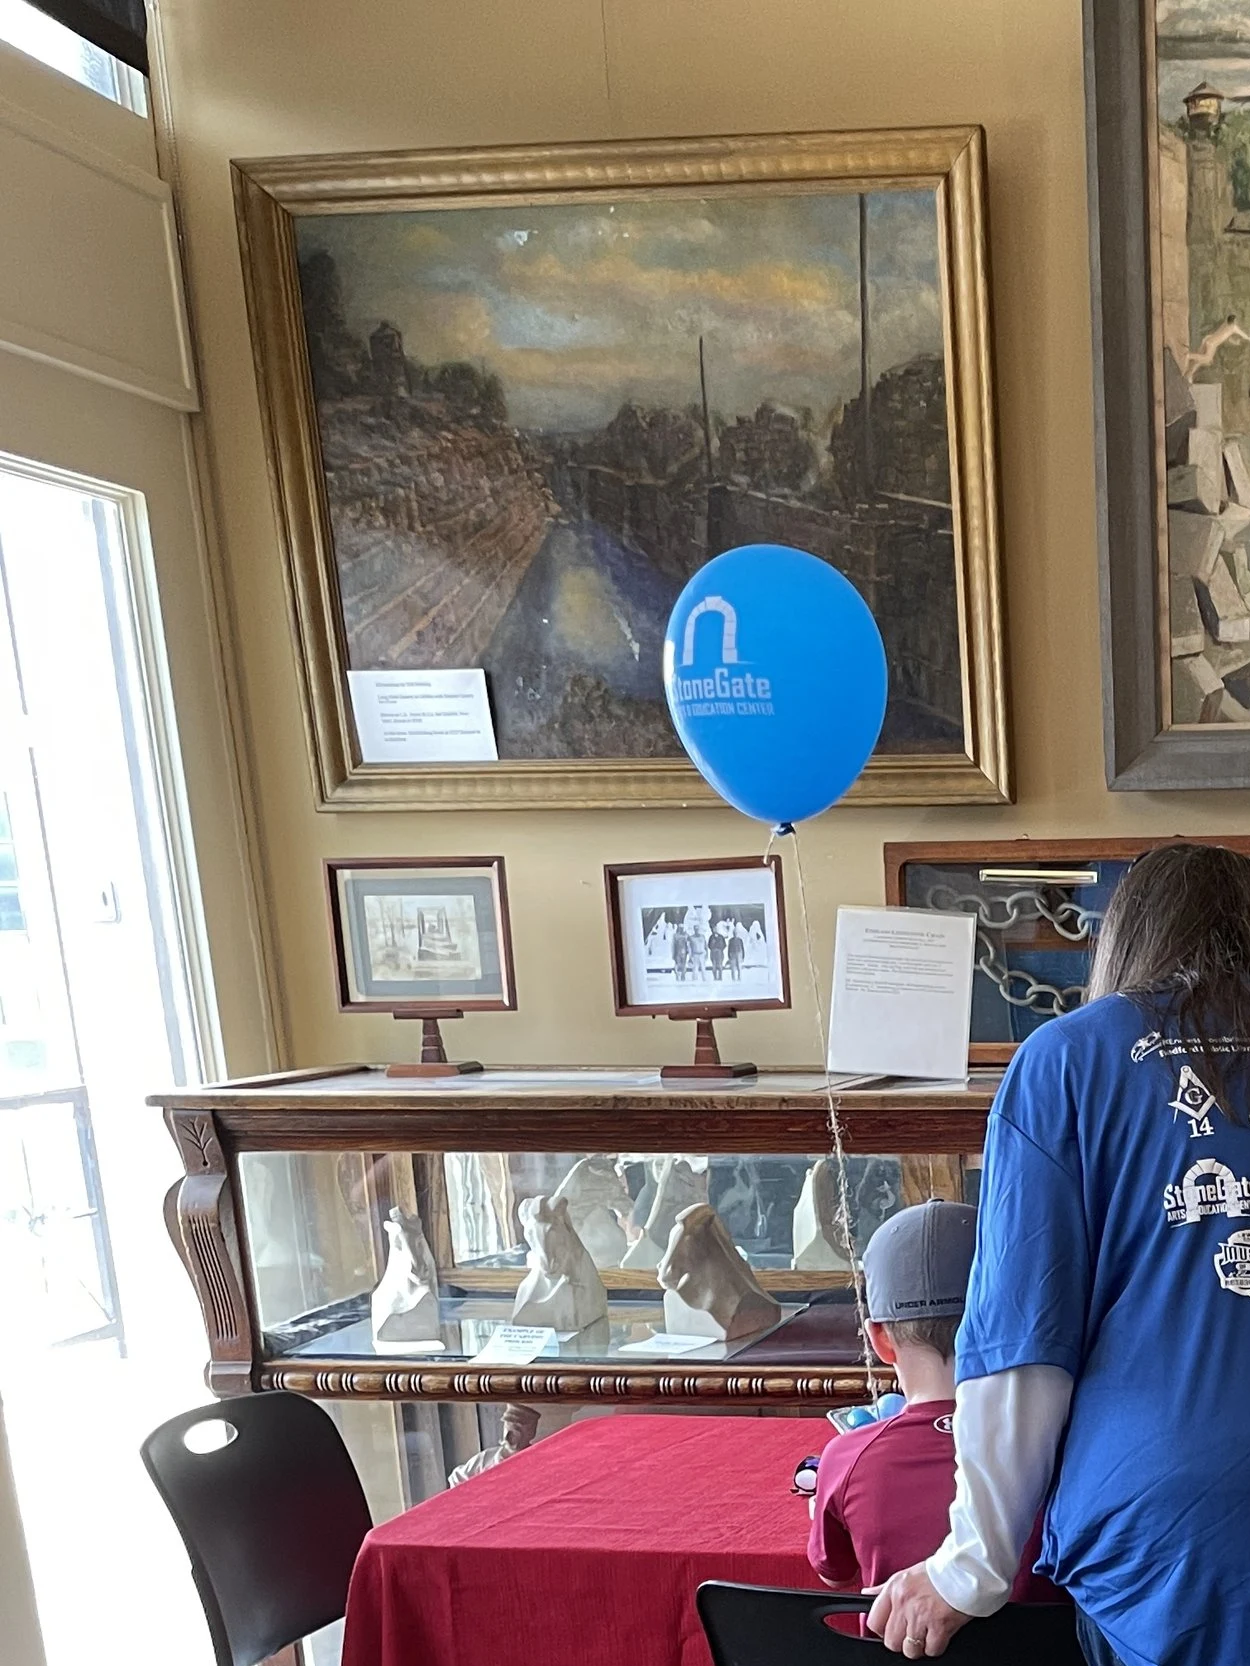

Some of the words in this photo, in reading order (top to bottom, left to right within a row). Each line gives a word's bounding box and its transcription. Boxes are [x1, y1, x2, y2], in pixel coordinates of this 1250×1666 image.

[1185, 1087, 1203, 1105] G
[1187, 1116, 1215, 1138] 14
[895, 1300, 927, 1309] UNDER
[929, 1297, 964, 1306] ARMO
